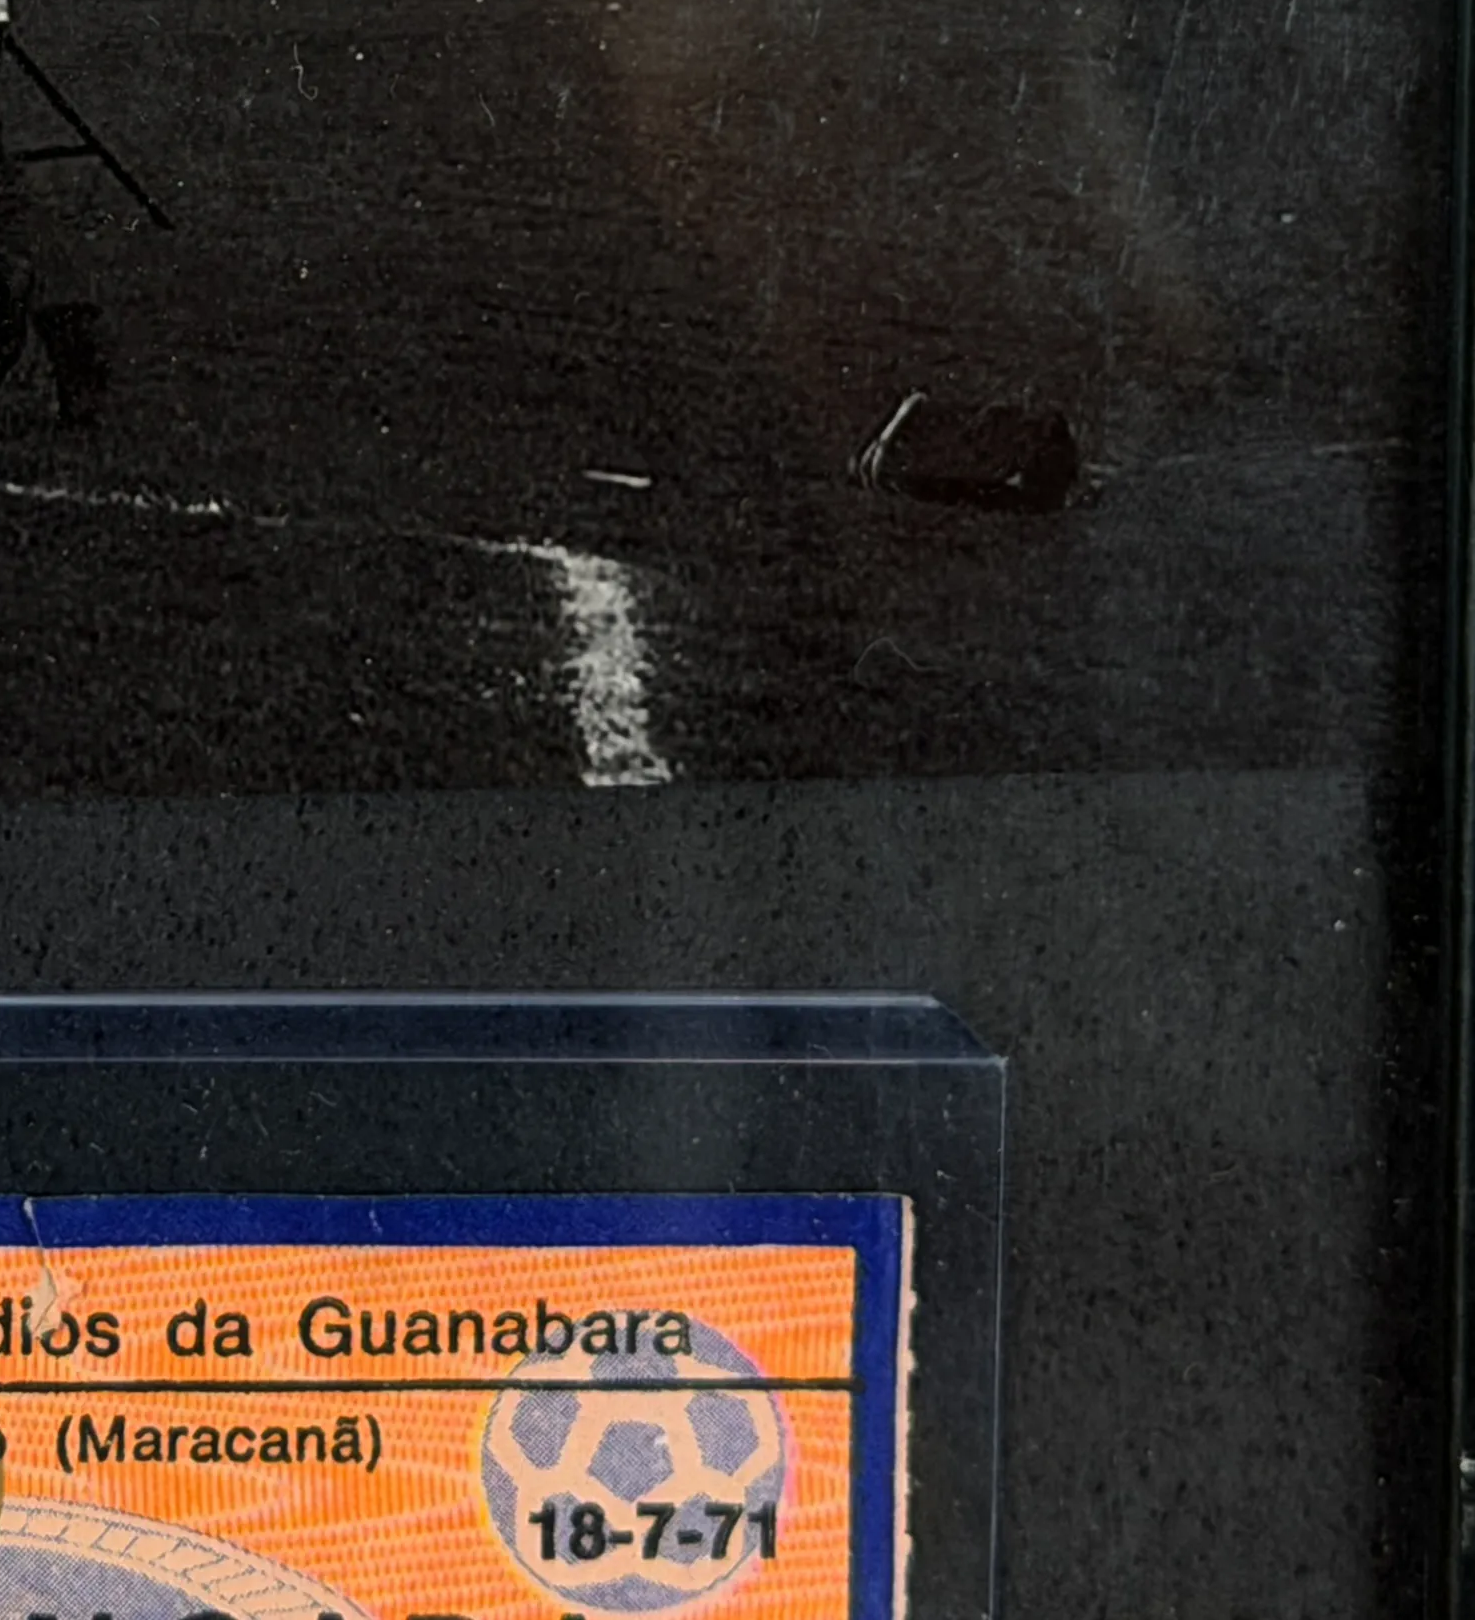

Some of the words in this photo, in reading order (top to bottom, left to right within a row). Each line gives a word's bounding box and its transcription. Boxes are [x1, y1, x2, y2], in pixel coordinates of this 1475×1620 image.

[165, 1297, 254, 1358] da
[296, 1298, 693, 1357] Guanabara
[55, 1414, 385, 1473] (Maracanã)
[528, 1501, 777, 1561] 18-7-71
